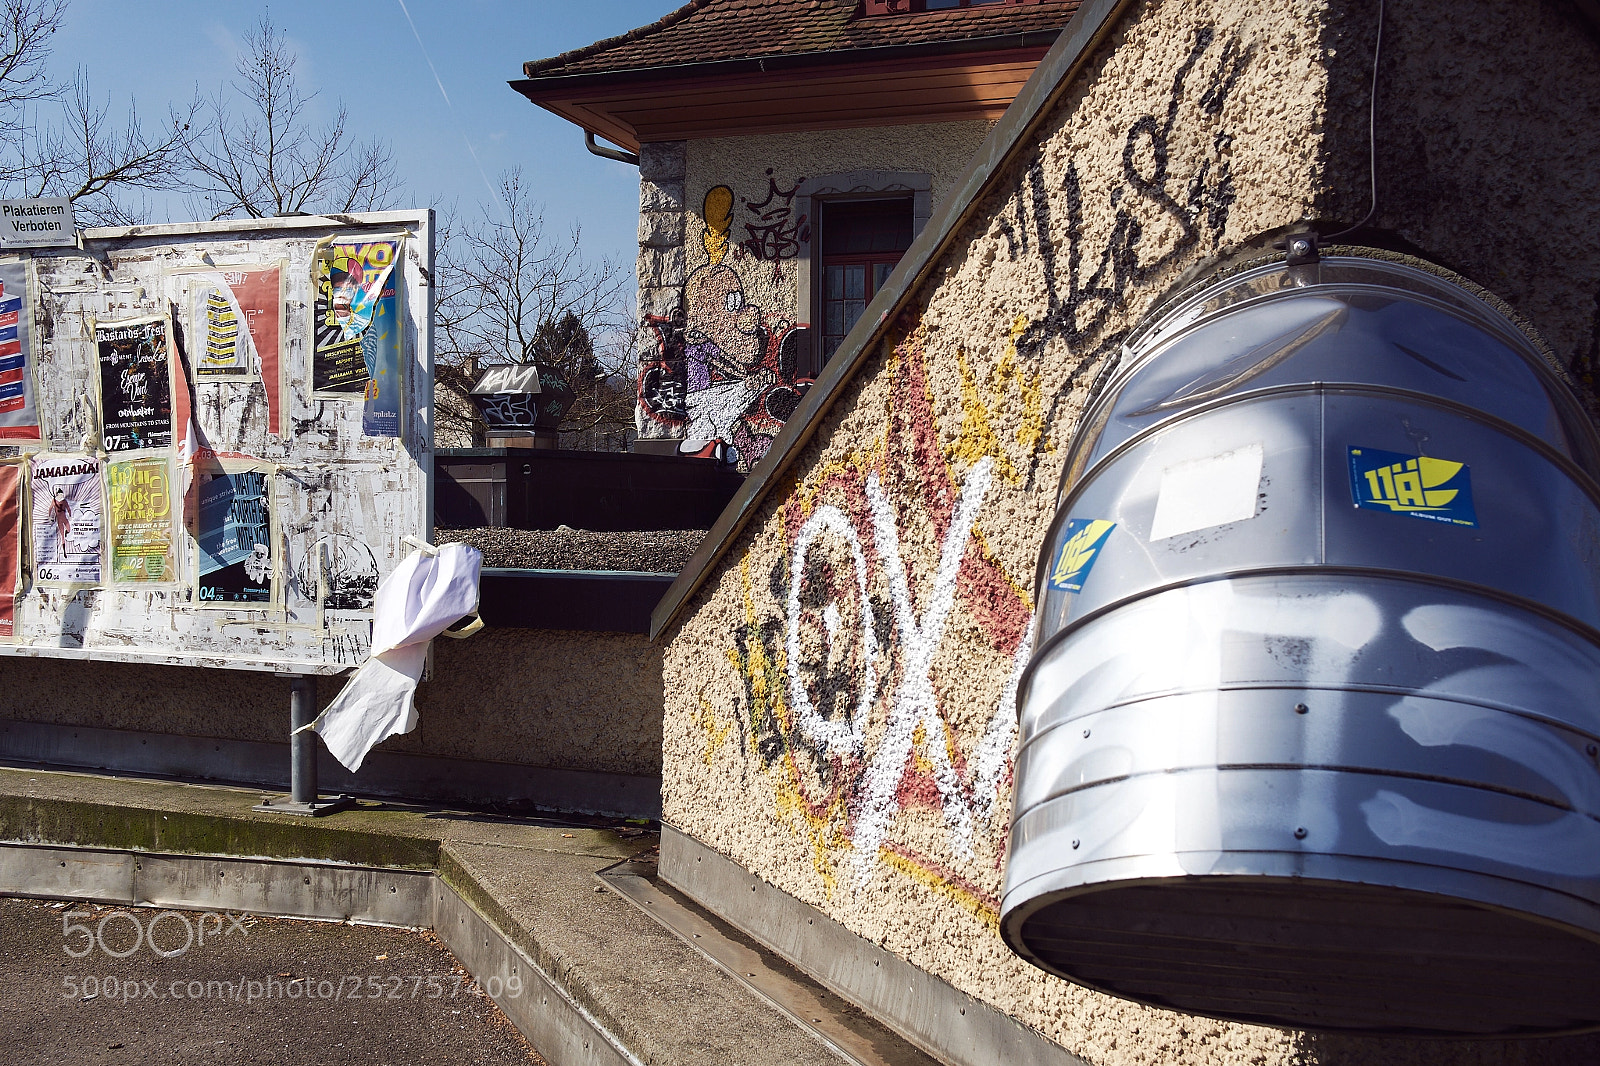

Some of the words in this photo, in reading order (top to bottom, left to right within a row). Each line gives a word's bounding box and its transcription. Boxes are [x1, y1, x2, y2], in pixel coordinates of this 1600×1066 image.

[2, 204, 65, 217] Plakatieren
[11, 219, 62, 232] Verboten
[33, 463, 99, 480] JAMARAMA!
[234, 473, 248, 495] MAY
[230, 499, 257, 523] FOURTH
[1410, 511, 1436, 520] ALBUM
[235, 526, 254, 550] WITH
